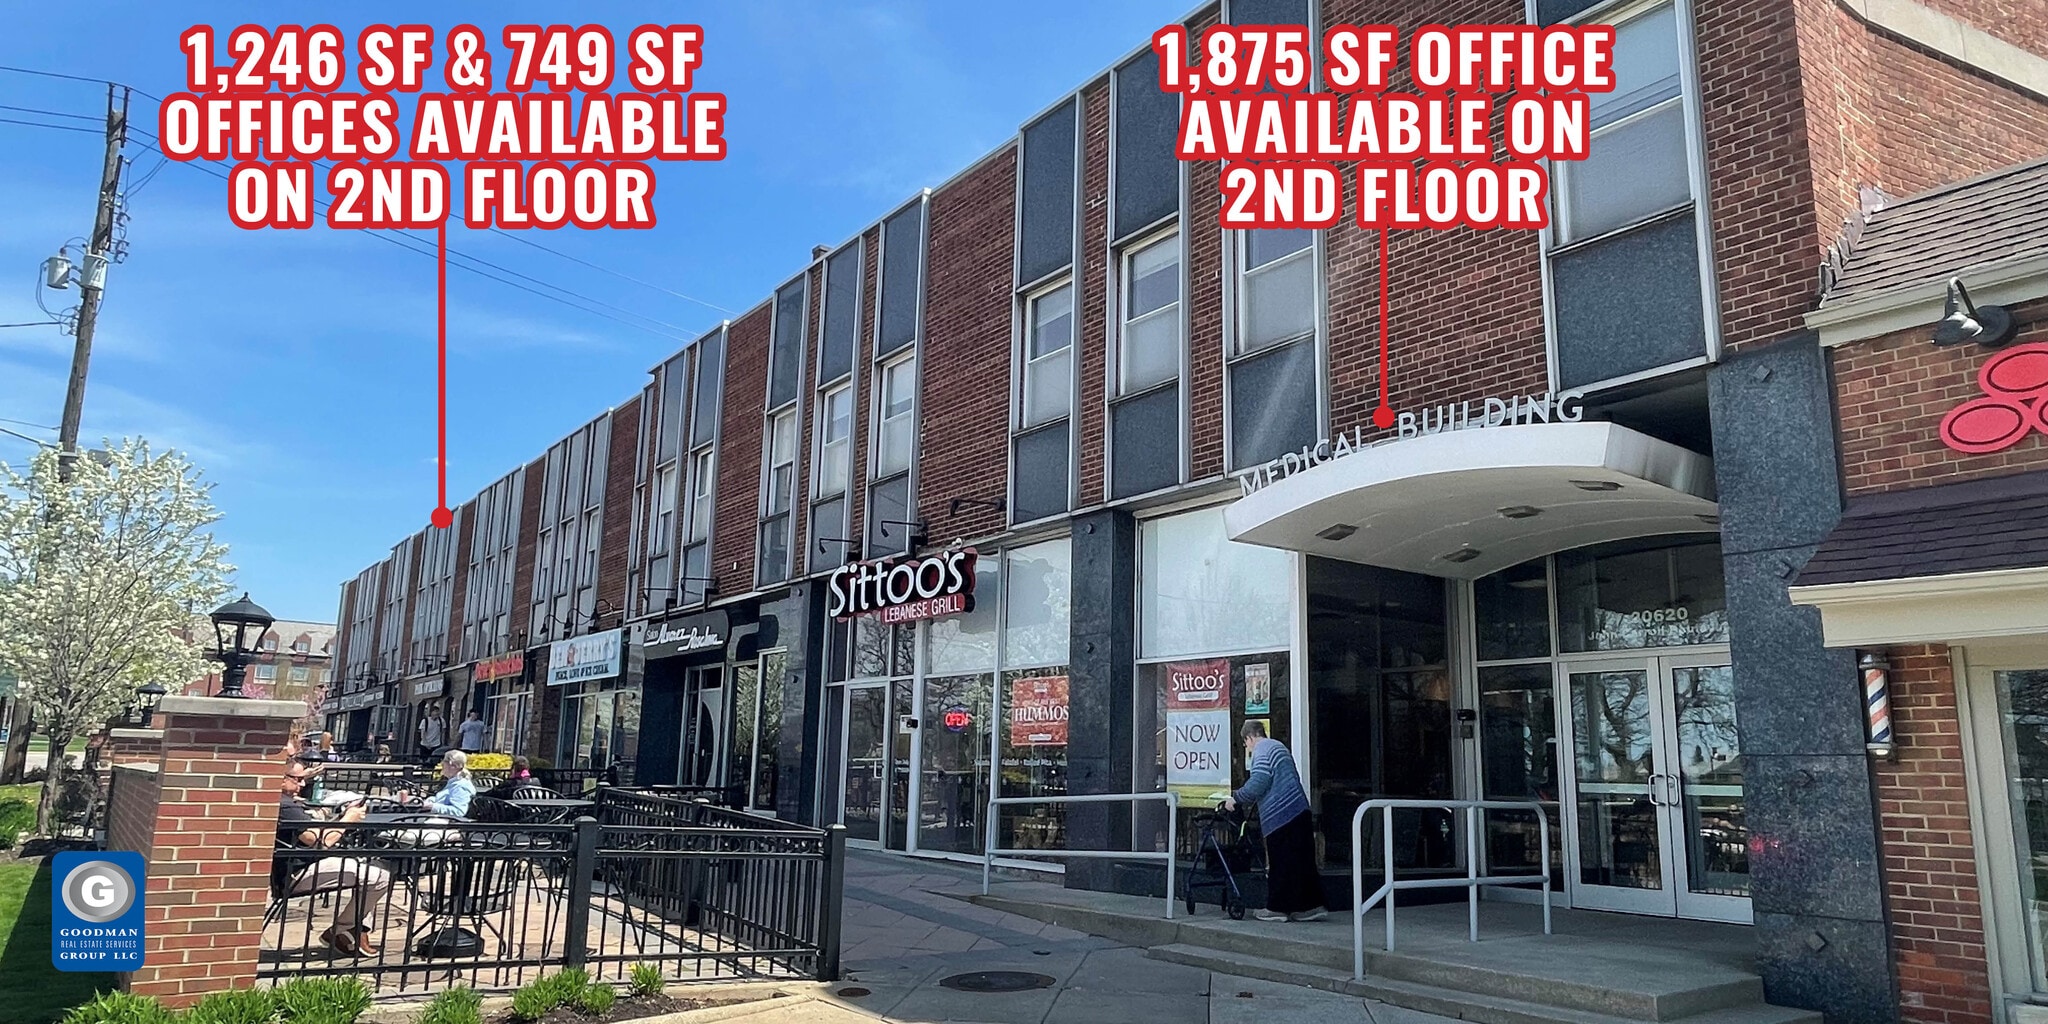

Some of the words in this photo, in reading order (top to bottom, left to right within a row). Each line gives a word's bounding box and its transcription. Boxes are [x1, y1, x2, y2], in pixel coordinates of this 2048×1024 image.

[1239, 425, 1373, 498] MEDICAL
[1398, 391, 1585, 439] BUILDING
[829, 550, 966, 618] Sittoo's
[884, 601, 928, 623] LEBANESE
[931, 596, 961, 615] GRILL
[1630, 607, 1689, 623] 20620
[1172, 669, 1225, 692] Sittoo's
[944, 713, 972, 727] OPEN
[1014, 705, 1070, 722] HUMMOS
[1175, 724, 1221, 743] NOW
[1174, 751, 1220, 770] OPEN
